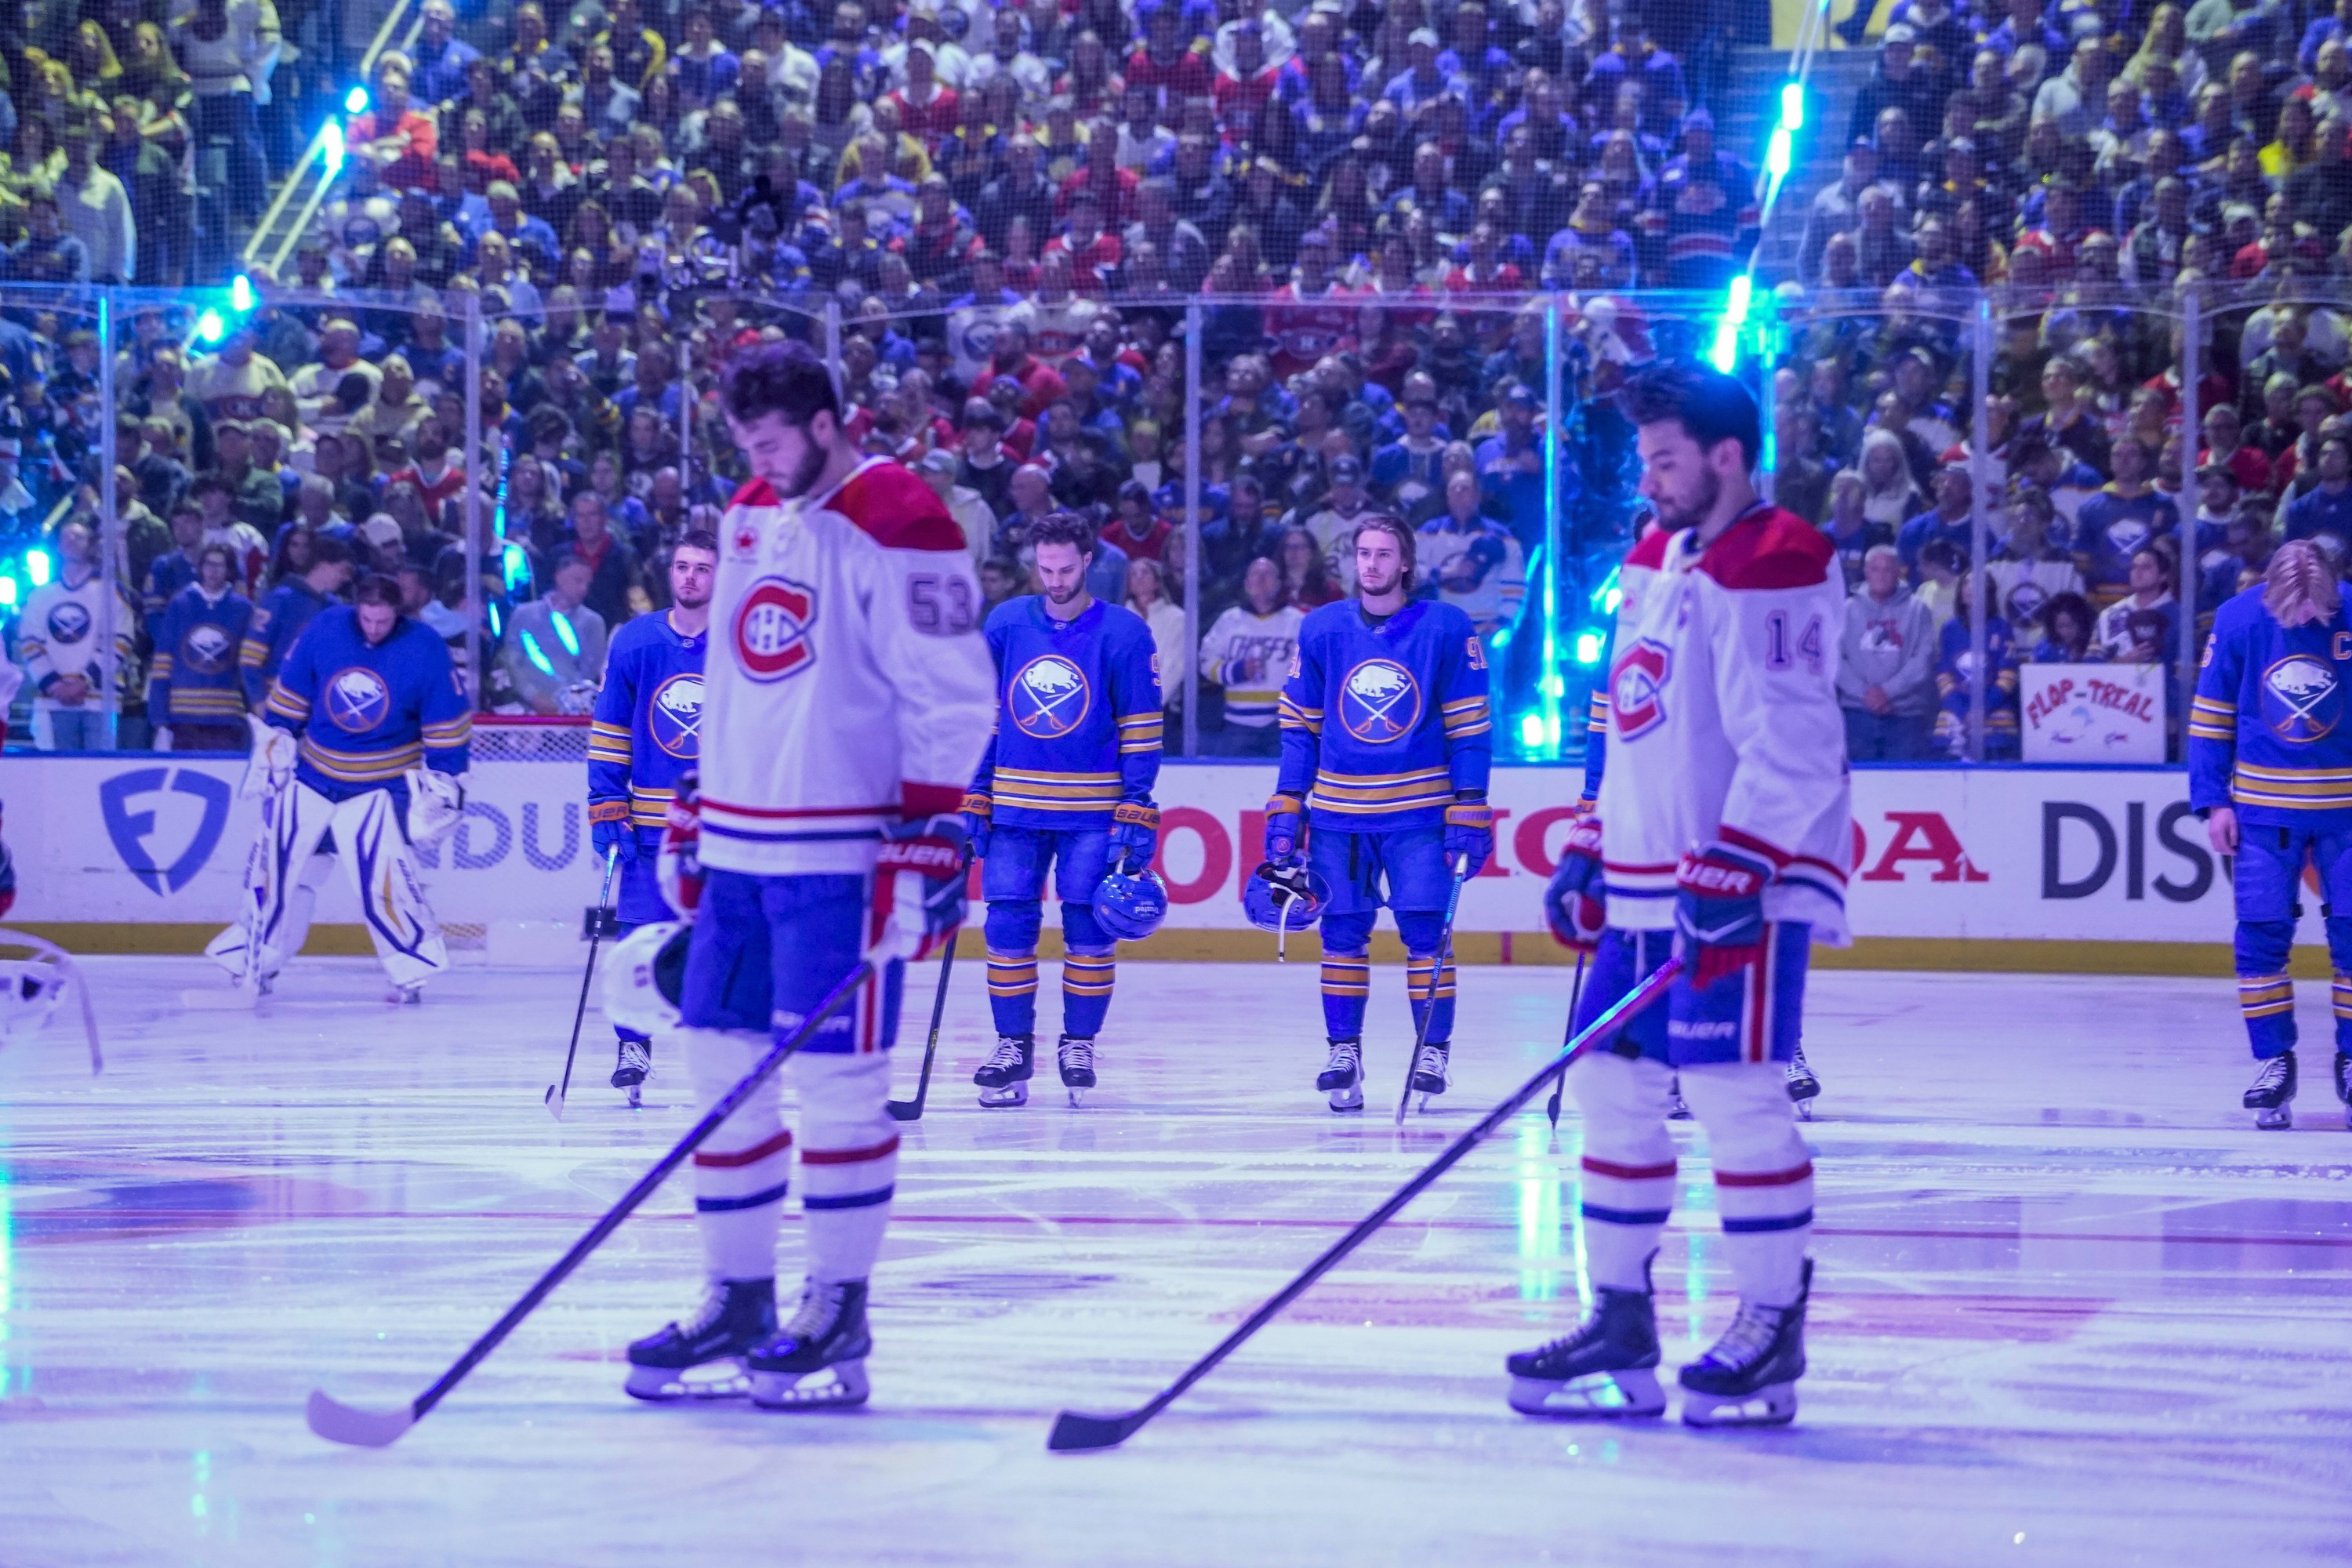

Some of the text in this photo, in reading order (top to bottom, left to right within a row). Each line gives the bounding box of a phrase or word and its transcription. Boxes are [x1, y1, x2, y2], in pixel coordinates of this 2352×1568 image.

[906, 572, 975, 637] 53
[1468, 635, 1489, 670] 91
[1766, 608, 1828, 676] 14
